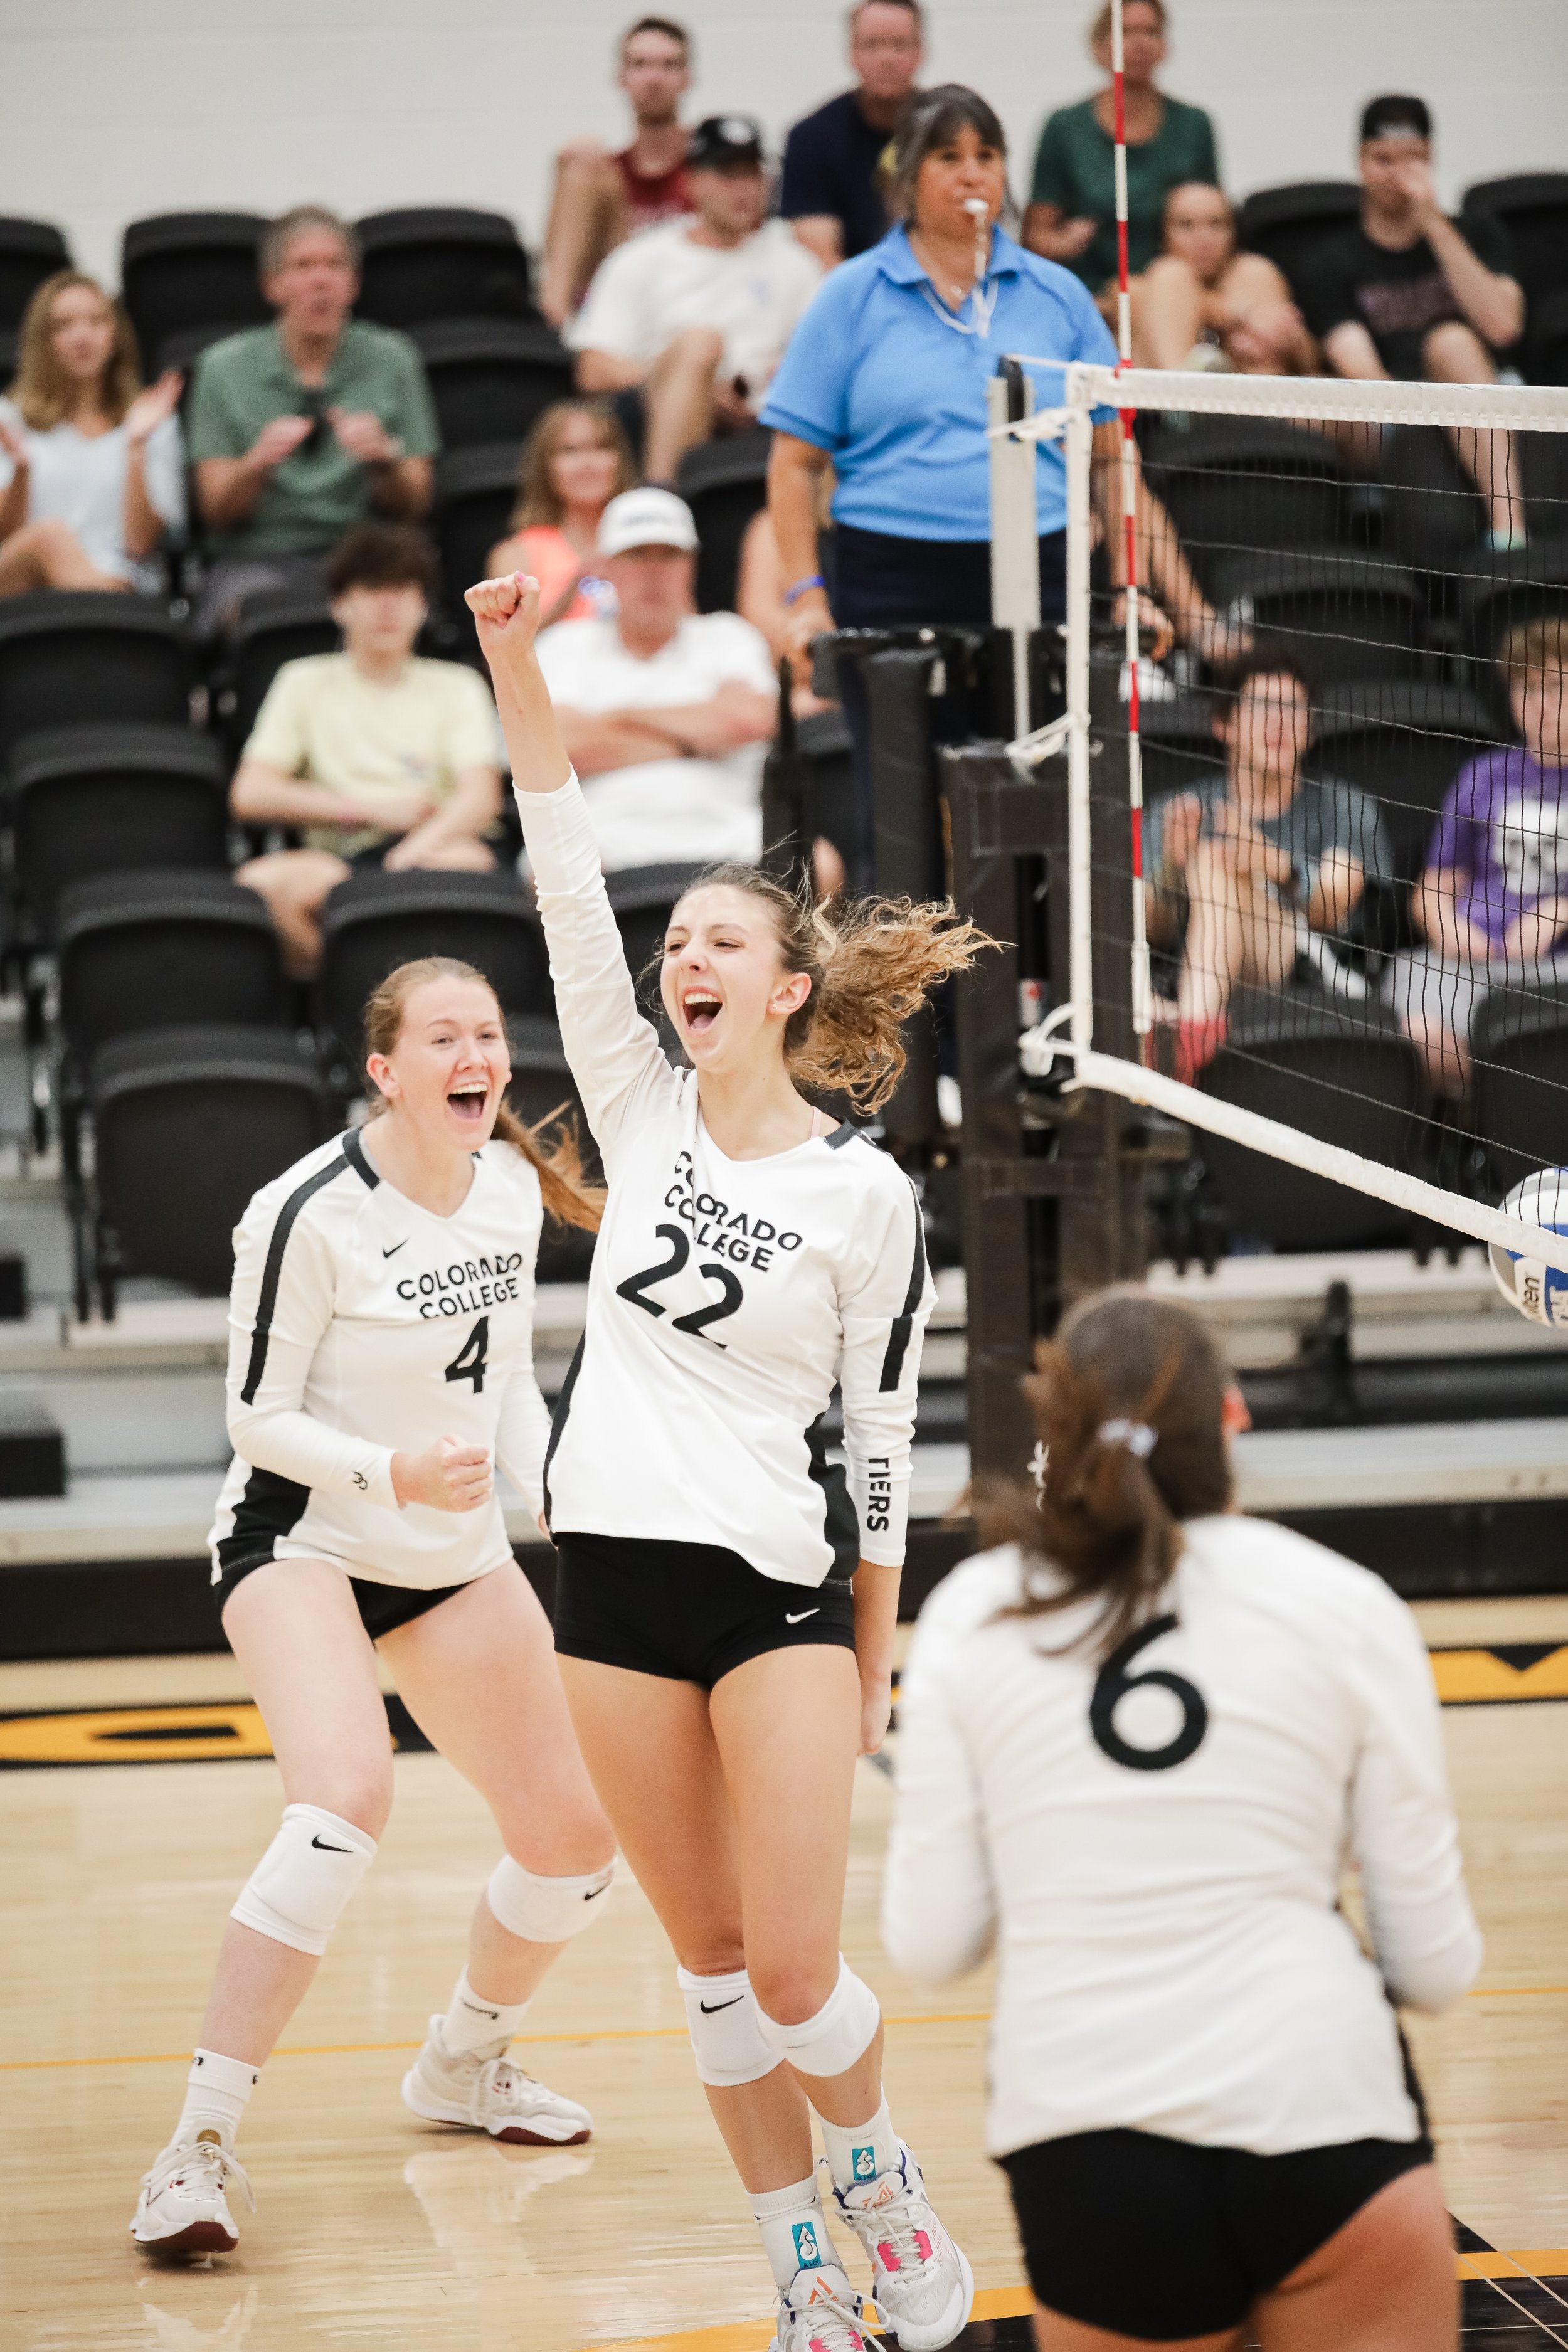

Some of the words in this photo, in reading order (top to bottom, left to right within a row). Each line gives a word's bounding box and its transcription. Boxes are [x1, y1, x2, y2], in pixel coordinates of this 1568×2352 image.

[664, 1184, 775, 1273] COLEGE
[674, 1150, 802, 1251] CORADO
[396, 1253, 522, 1300] COLORADO
[420, 1277, 519, 1320] COLLEGE
[616, 1223, 743, 1350] 22
[444, 1315, 490, 1394] 4
[1089, 1613, 1207, 1770] 6
